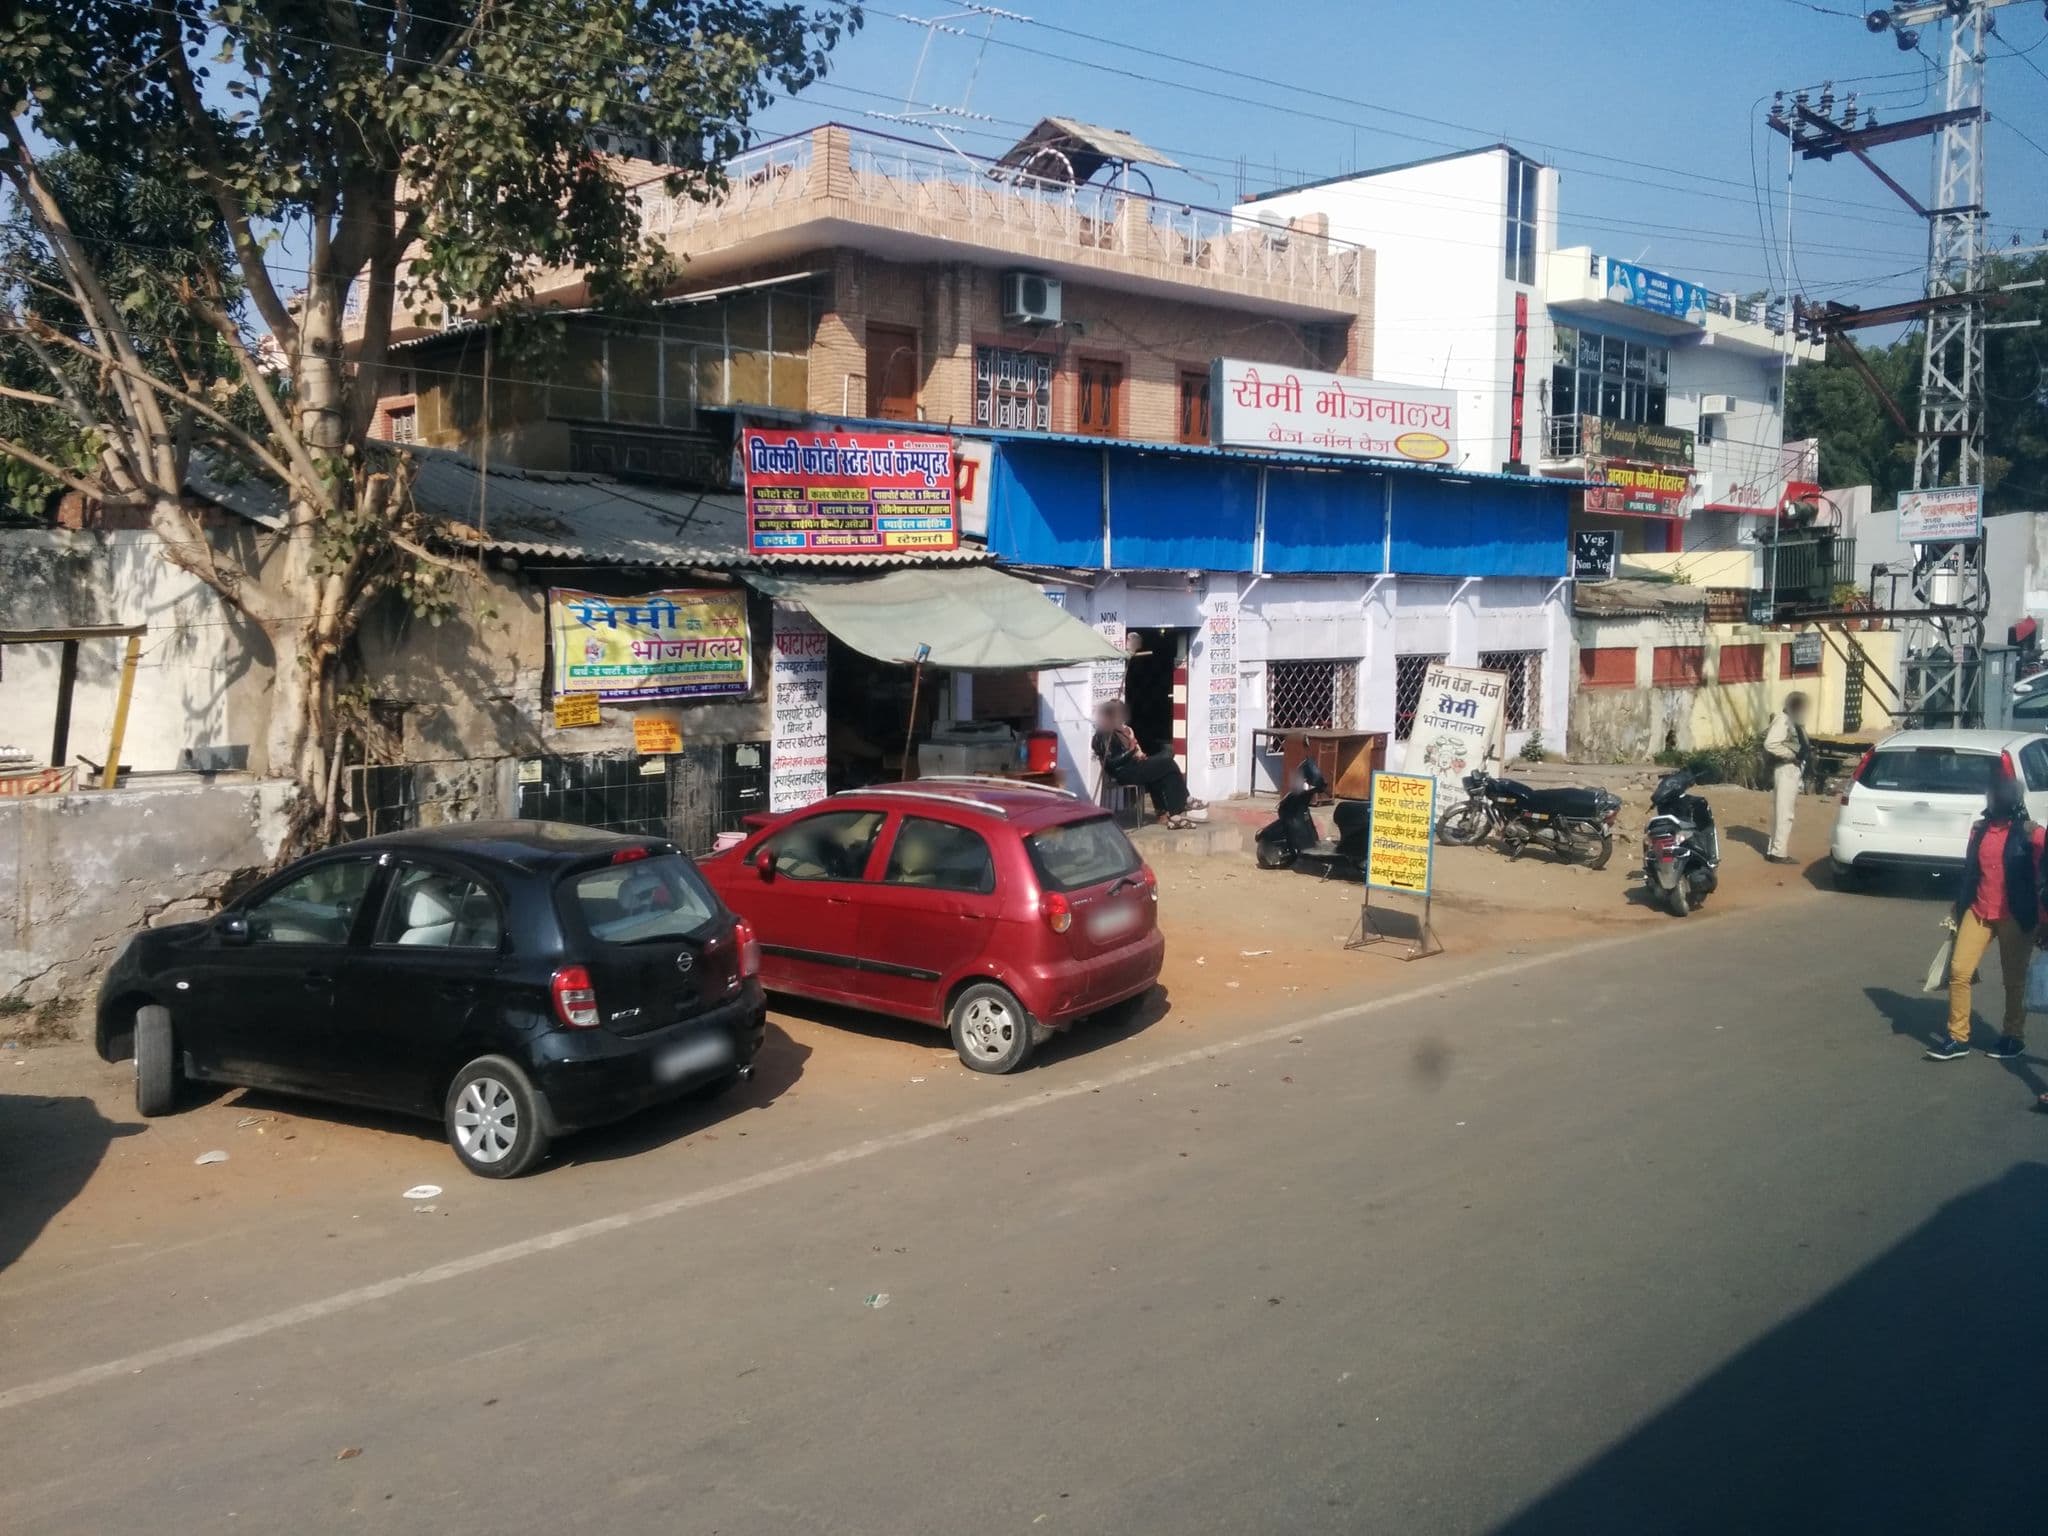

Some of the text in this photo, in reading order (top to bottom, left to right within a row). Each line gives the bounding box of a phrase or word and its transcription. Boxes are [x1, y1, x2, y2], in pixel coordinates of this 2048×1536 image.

[1229, 368, 1453, 430] सैमी भोजनालय
[1268, 423, 1303, 445] वेज
[1312, 428, 1352, 449] नॉन
[1359, 432, 1390, 454] वेज
[750, 436, 800, 475] विक्की
[801, 438, 840, 475] फोटो
[840, 439, 869, 476] स्टेट
[871, 440, 895, 477] एवं
[757, 488, 800, 499] फोटो स्टेट
[831, 488, 850, 499] फोटो
[1100, 611, 1117, 623] NON
[1214, 601, 1229, 613] VEG
[1103, 625, 1116, 636] VEG
[631, 633, 744, 660] भोजनालय
[776, 627, 803, 655] फोटो
[1428, 669, 1451, 689] नॉन
[804, 704, 822, 719] फोटो
[1438, 692, 1479, 719] सैमी
[1423, 711, 1485, 736] भोजनालय
[1379, 776, 1399, 793] फोटो
[1402, 778, 1426, 796] स्टेट
